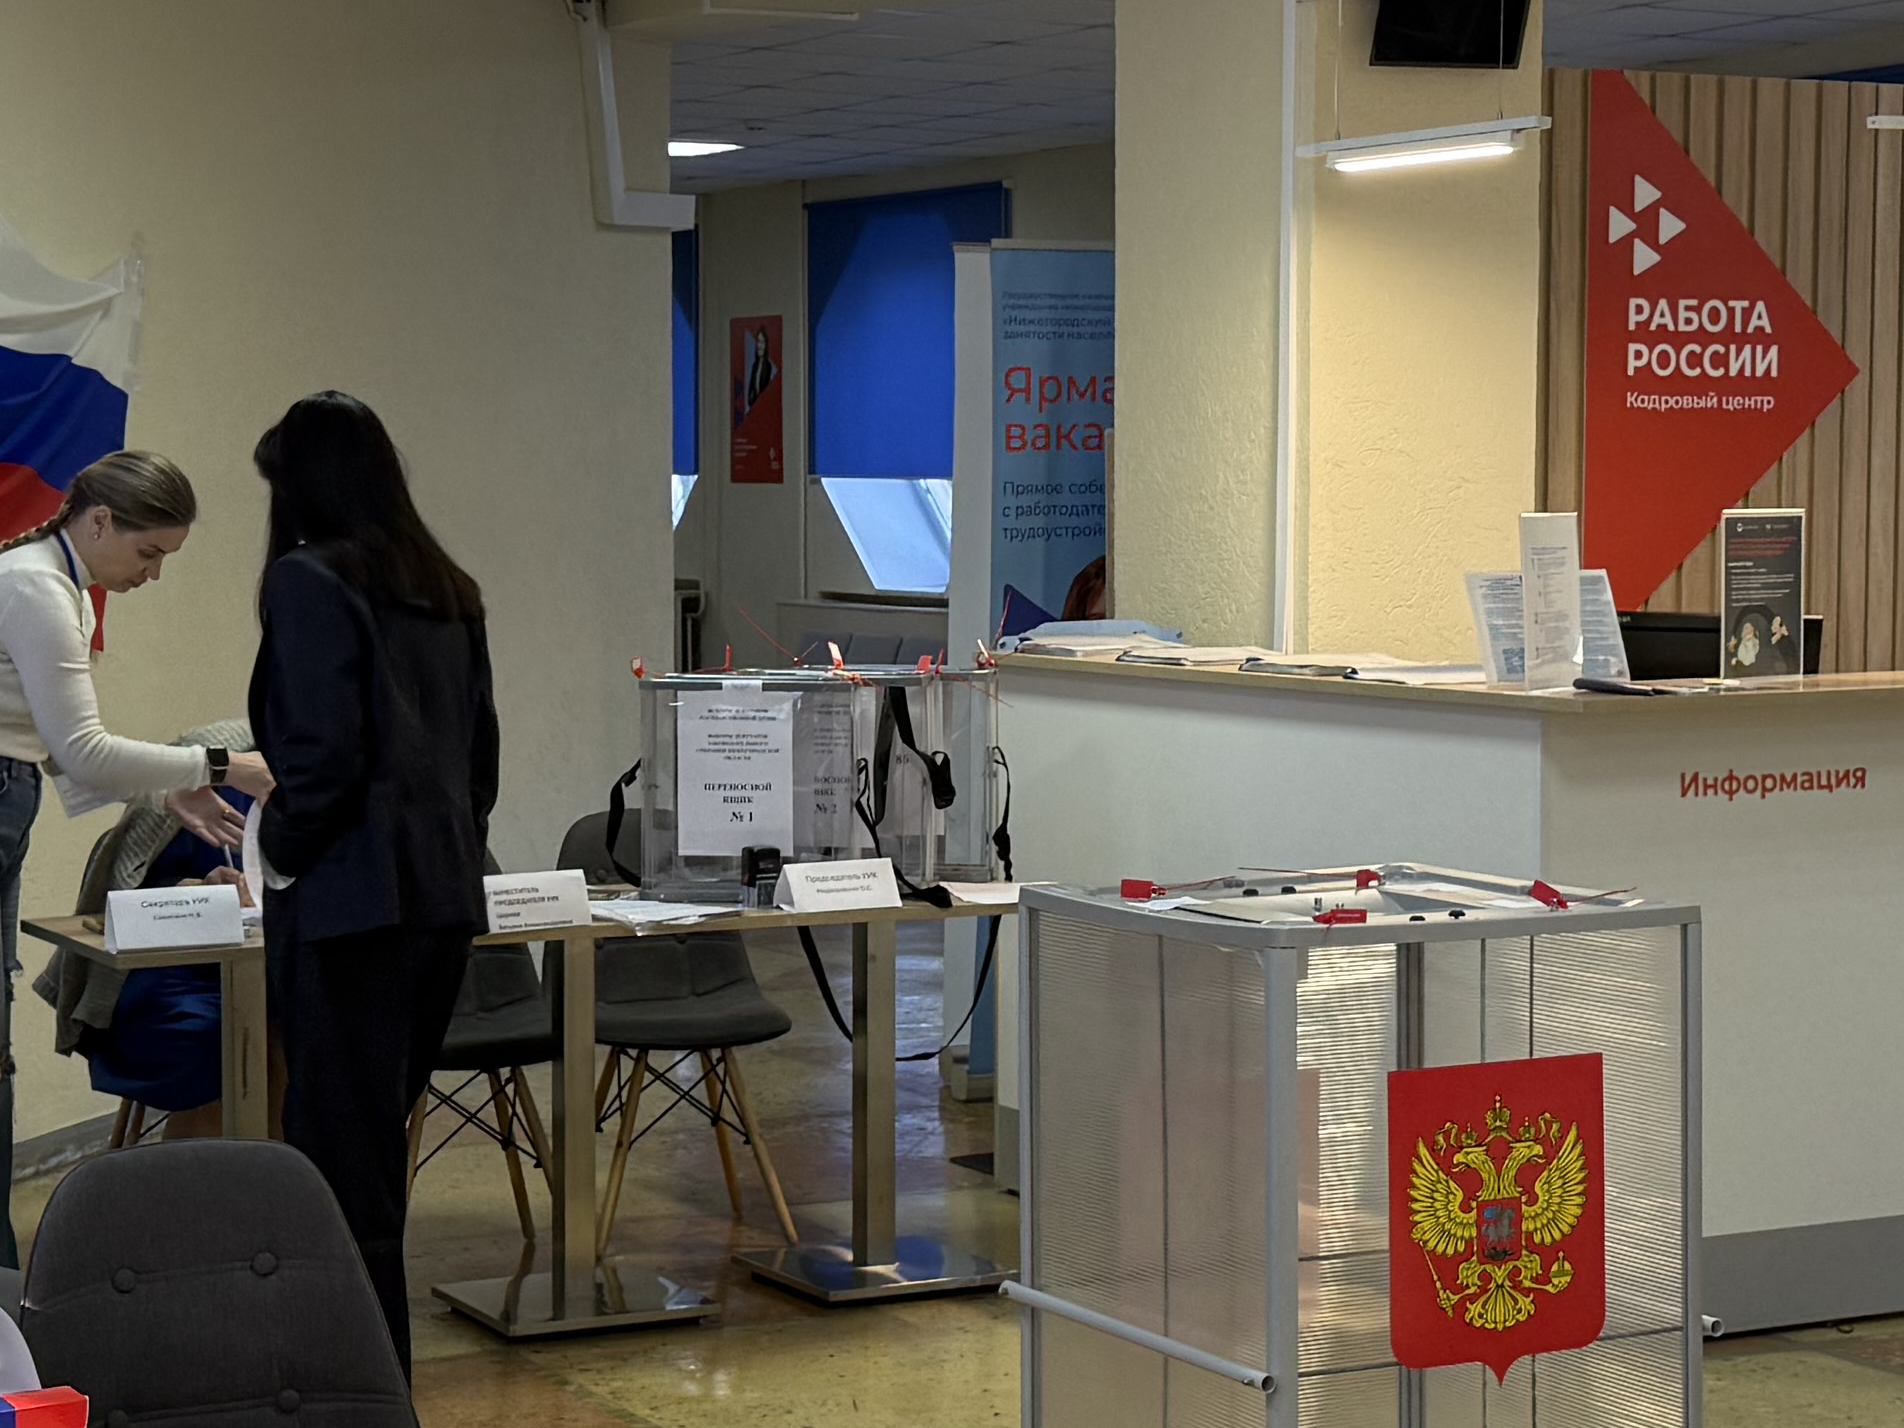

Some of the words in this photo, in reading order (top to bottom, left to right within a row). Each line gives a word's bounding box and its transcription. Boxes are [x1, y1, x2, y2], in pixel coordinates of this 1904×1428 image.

[1627, 297, 1773, 335] РАБОТА
[1627, 342, 1779, 379] РОССИИ
[1626, 391, 1720, 413] Кадровый
[1721, 394, 1775, 413] центр
[1004, 423, 1105, 453] вака
[1003, 481, 1064, 498] Прямое
[1003, 526, 1107, 543] трудоустрой
[1680, 767, 1867, 802] Информация
